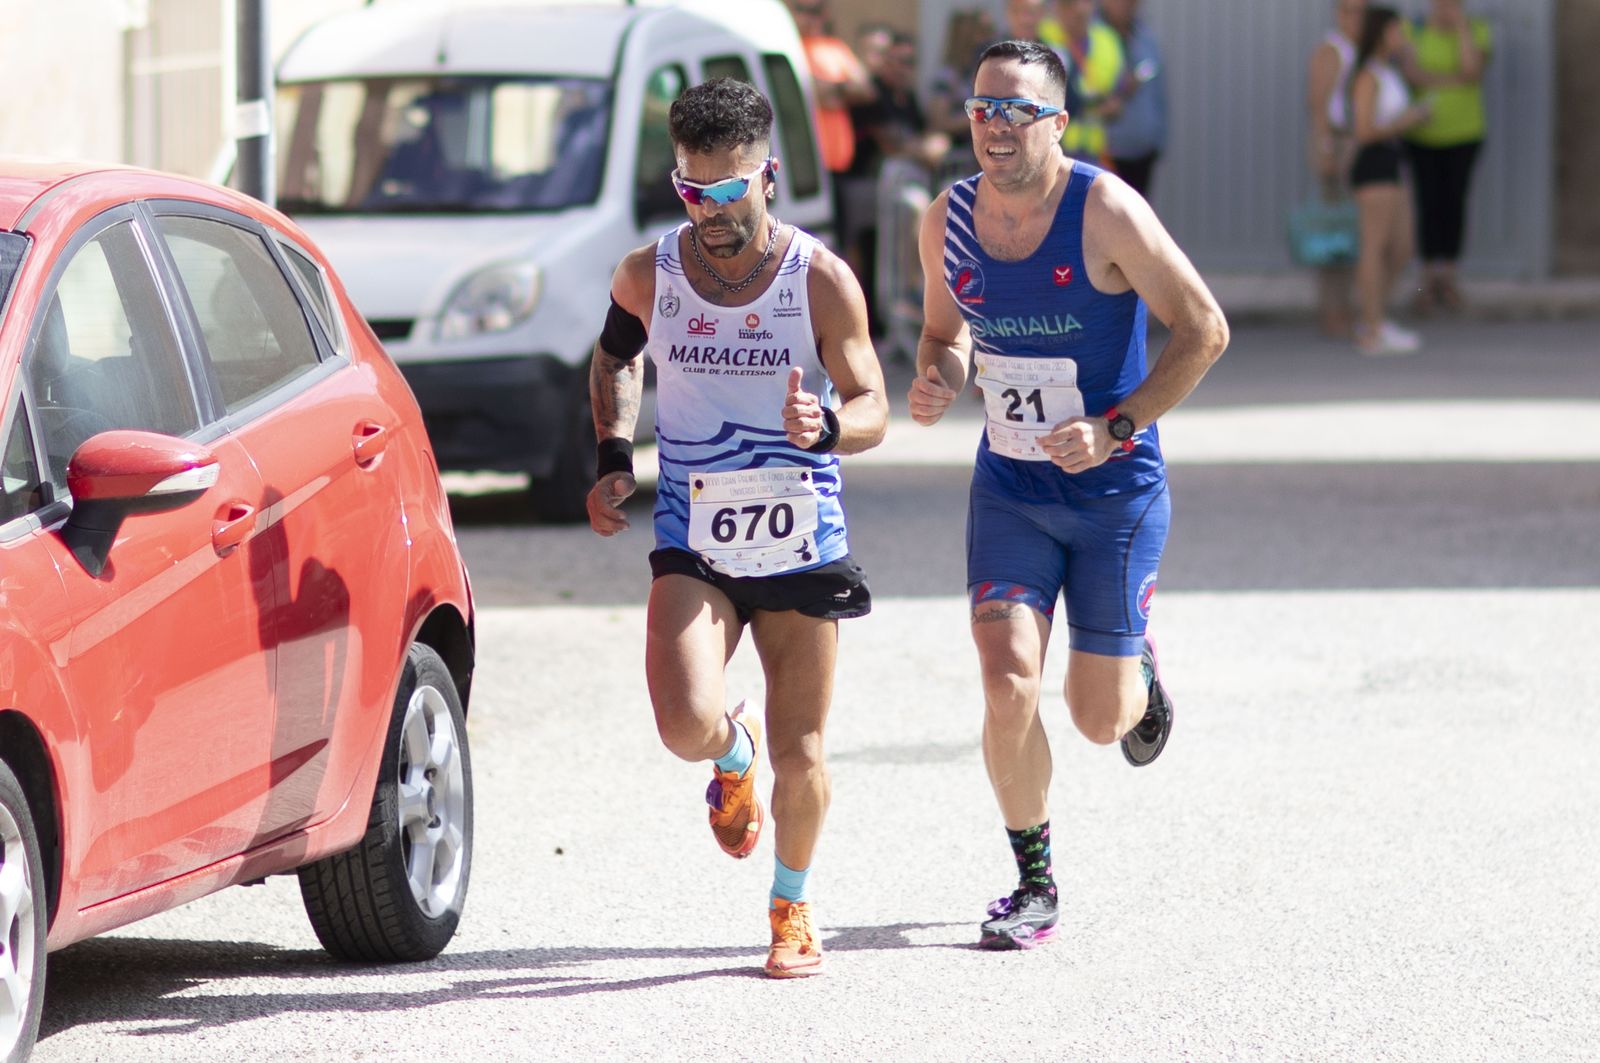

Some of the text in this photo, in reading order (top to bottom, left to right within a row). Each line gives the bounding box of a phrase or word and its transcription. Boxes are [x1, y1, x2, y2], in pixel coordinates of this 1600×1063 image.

[687, 313, 716, 335] als
[739, 330, 774, 342] mayfo
[668, 344, 791, 367] MARACENA
[683, 366, 706, 374] CLUB
[723, 369, 776, 377] ATLETISMO
[1001, 388, 1046, 423] 21
[711, 502, 794, 543] 670
